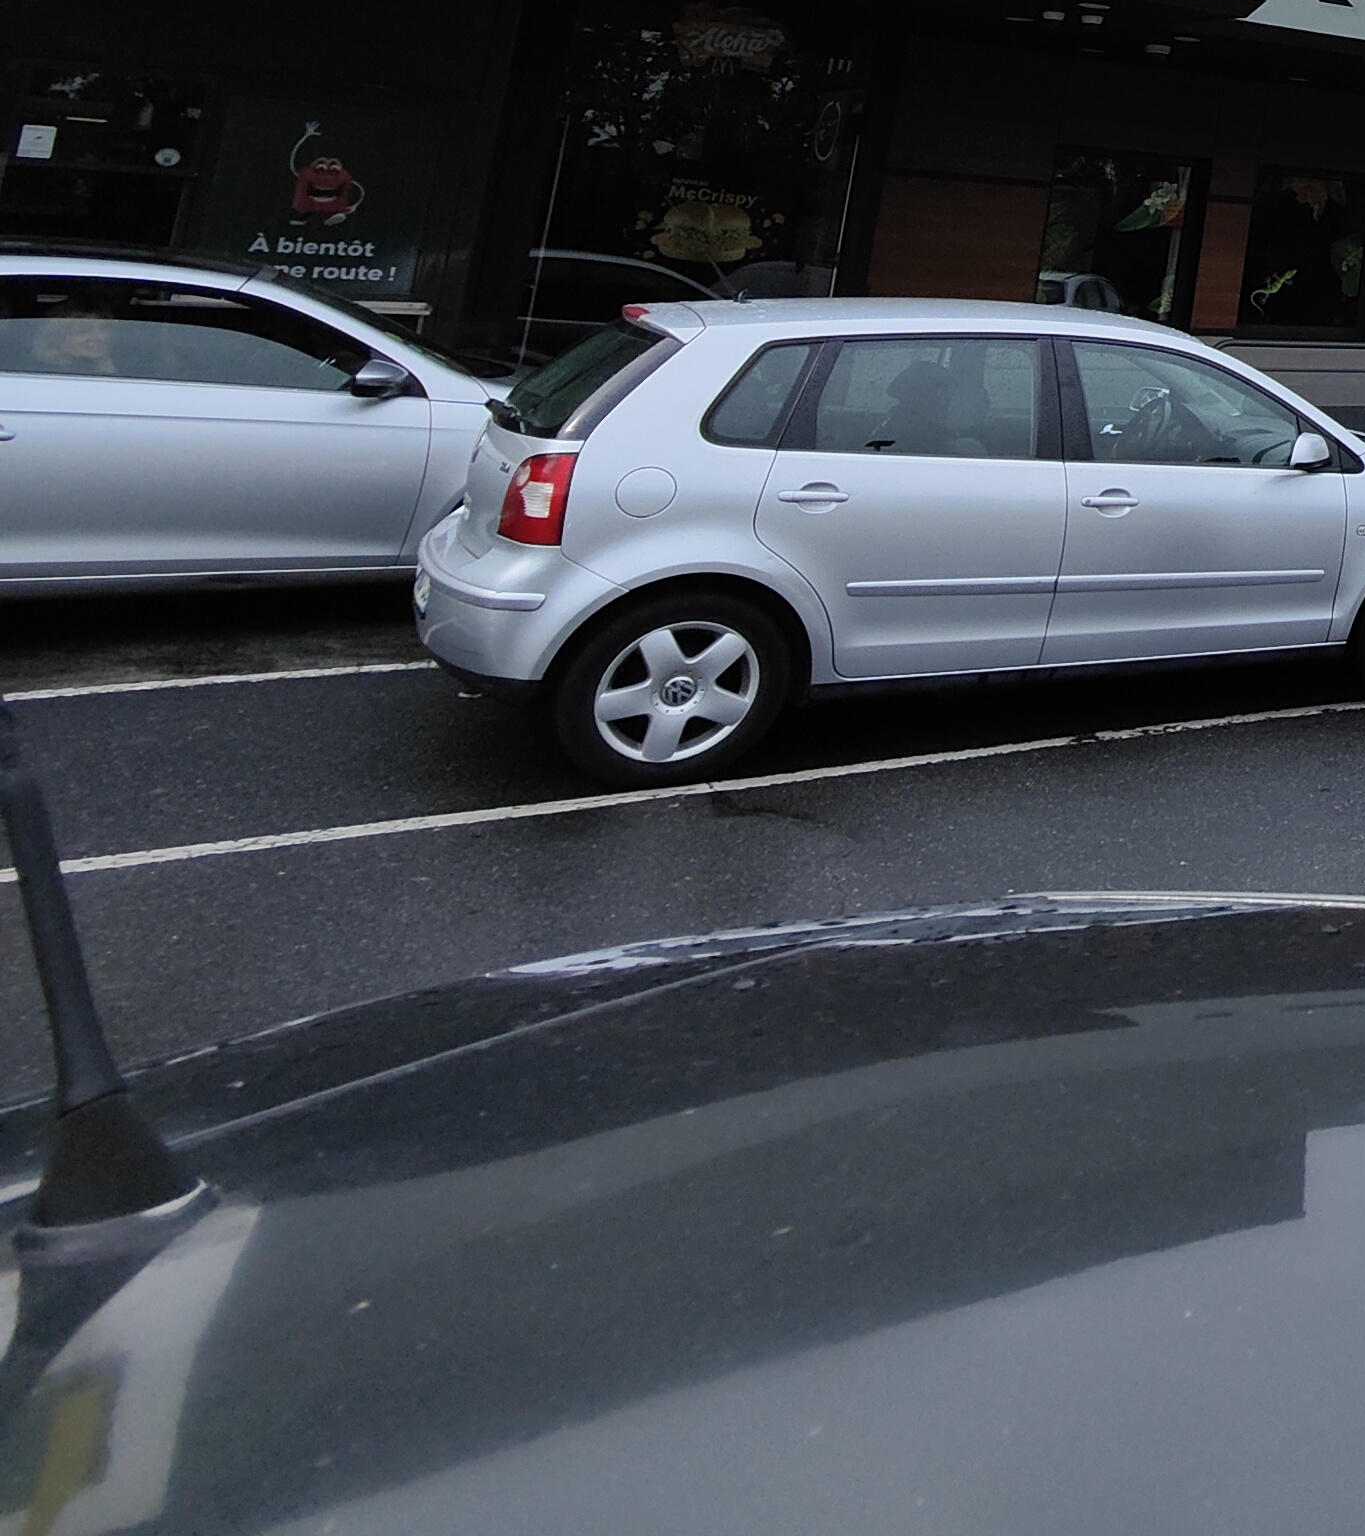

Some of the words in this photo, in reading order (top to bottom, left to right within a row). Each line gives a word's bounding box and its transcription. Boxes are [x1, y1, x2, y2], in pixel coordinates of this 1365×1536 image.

[668, 185, 758, 209] McCrispy
[247, 231, 270, 253] À
[275, 236, 376, 258] bientôt
[311, 265, 384, 282] route
